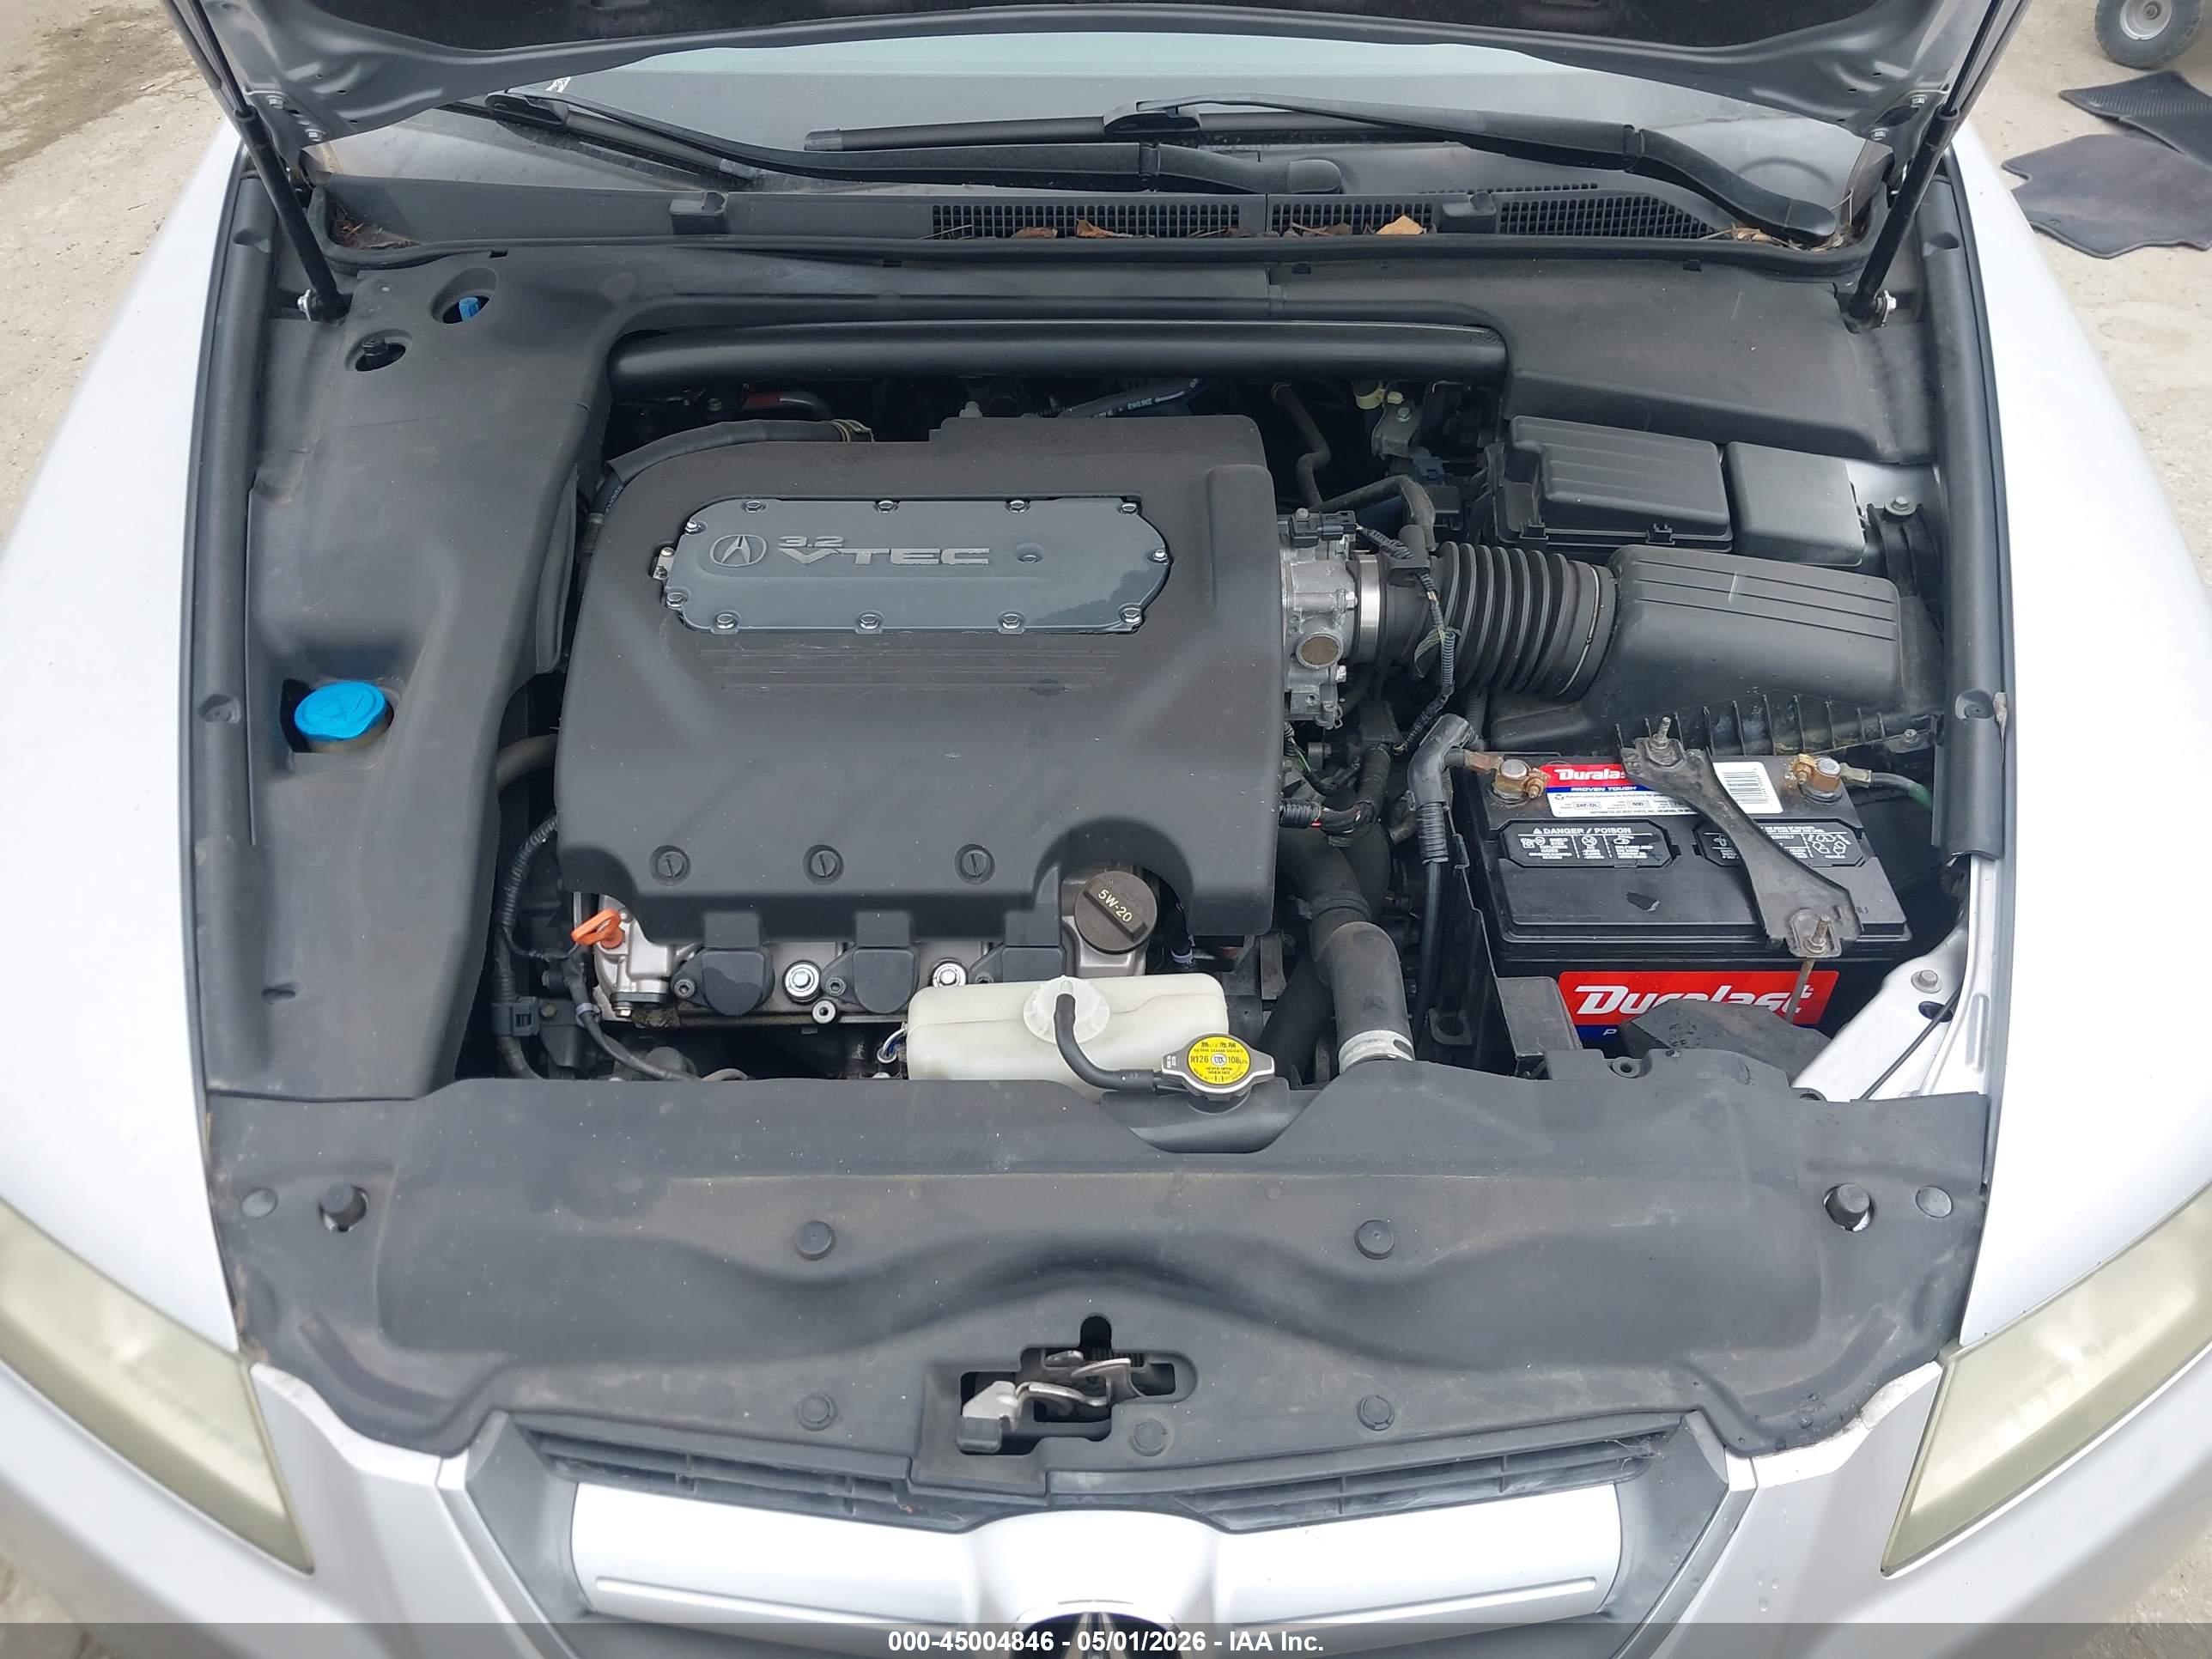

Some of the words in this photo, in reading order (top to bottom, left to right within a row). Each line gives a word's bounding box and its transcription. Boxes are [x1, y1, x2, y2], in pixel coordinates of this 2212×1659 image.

[779, 536, 843, 548] 3.2
[779, 548, 989, 565] VTEC
[1554, 769, 1625, 781] Durala
[1098, 889, 1133, 922] 5W-20
